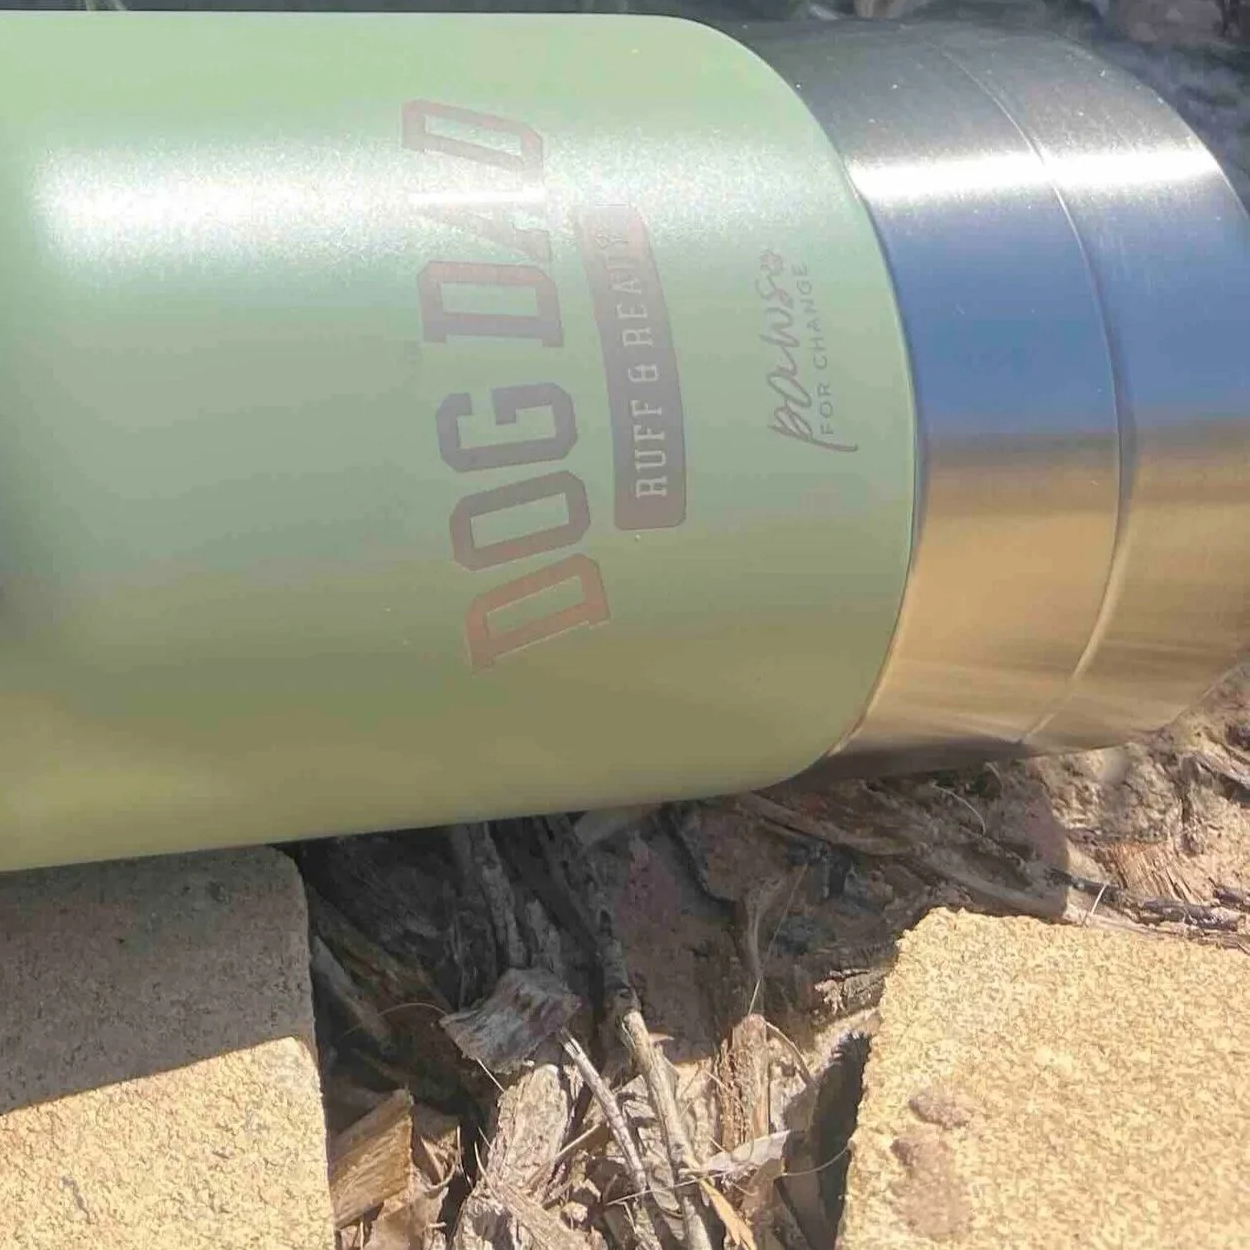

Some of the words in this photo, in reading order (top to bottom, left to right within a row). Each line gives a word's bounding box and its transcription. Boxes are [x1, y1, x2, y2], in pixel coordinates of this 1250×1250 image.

[791, 260, 828, 371] CHANGE
[627, 364, 659, 383] &
[816, 382, 834, 436] FOR
[630, 398, 668, 500] RUFF
[436, 382, 611, 672] DOG
